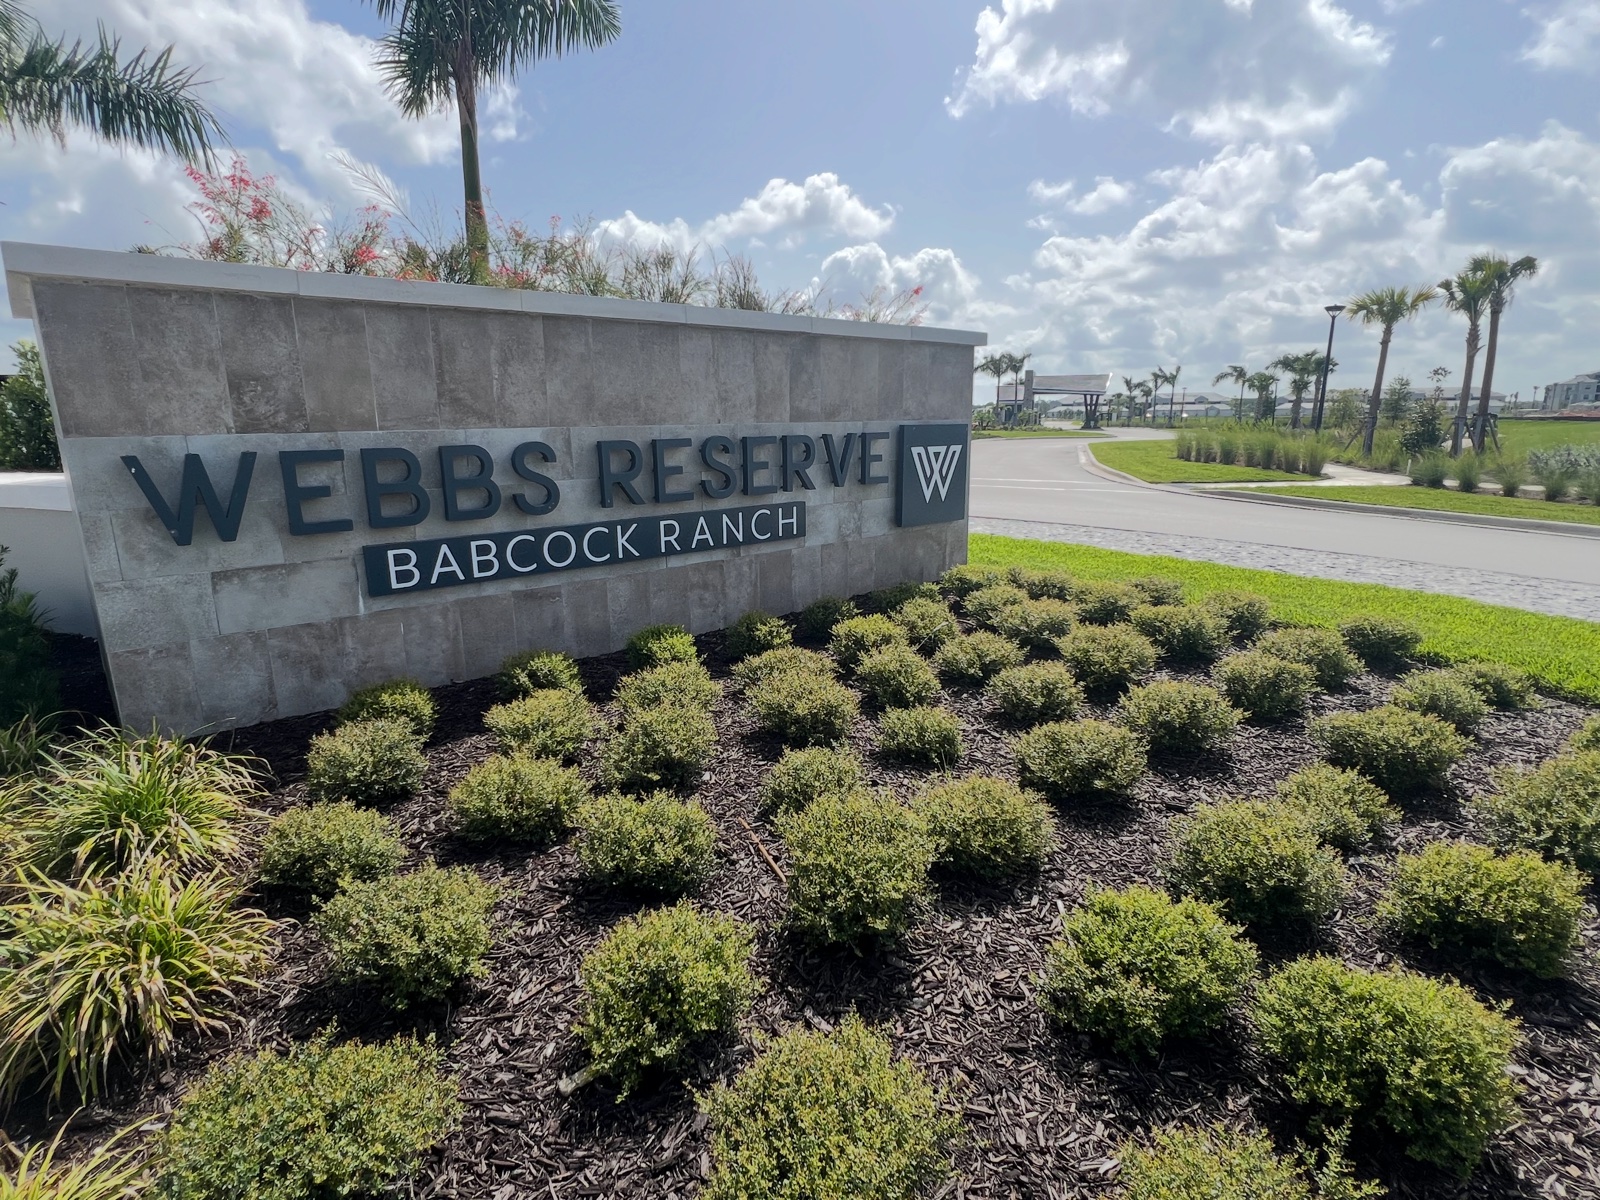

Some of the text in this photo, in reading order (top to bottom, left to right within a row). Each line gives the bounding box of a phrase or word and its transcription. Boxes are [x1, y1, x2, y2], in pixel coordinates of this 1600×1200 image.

[120, 432, 890, 546] WEBBS RESERVE
[387, 506, 798, 590] BABCOCK RANCH
